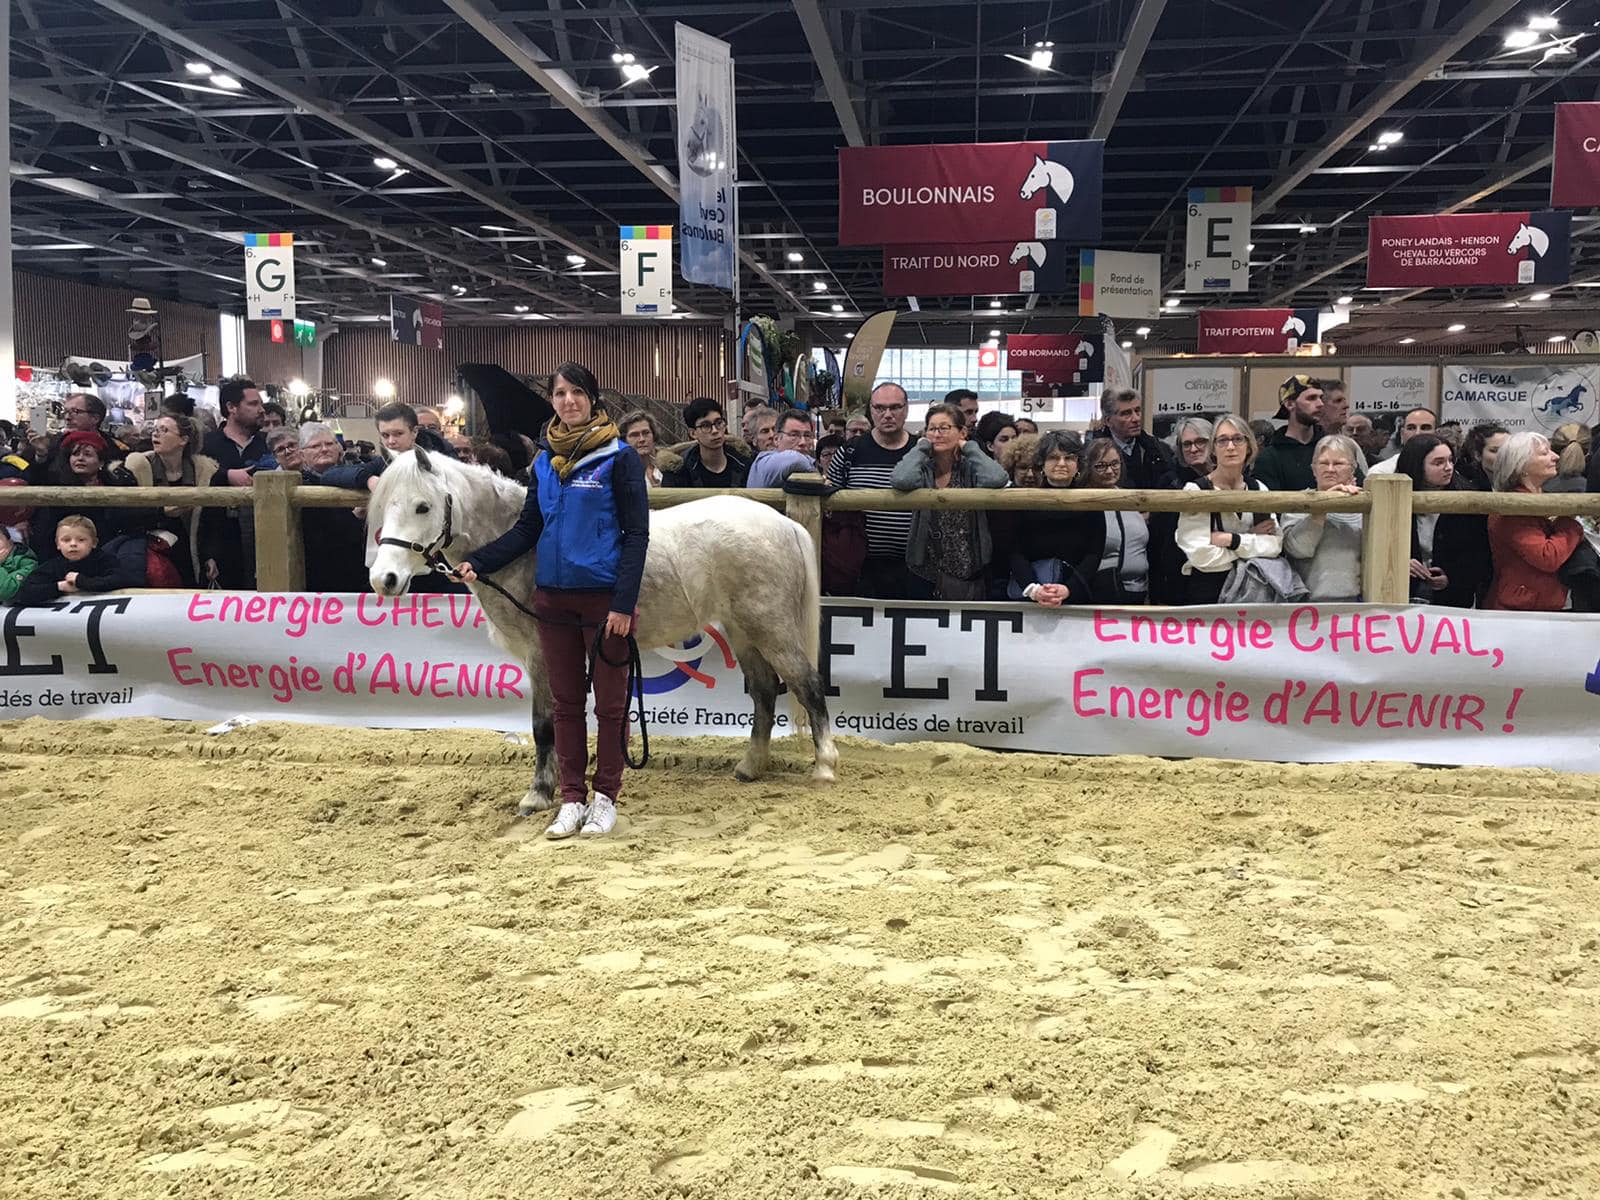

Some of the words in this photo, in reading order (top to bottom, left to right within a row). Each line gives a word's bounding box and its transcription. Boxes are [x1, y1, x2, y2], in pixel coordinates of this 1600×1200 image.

[863, 186, 995, 206] BOULONNAIS
[1189, 205, 1202, 217] 6.
[1206, 217, 1232, 258] E
[1382, 238, 1413, 247] PONEY
[1414, 237, 1453, 246] LANDAIS
[1461, 236, 1499, 245] HENSON
[622, 240, 632, 251] 6.
[246, 248, 256, 258] 6.
[1393, 249, 1428, 258] CHEVAL
[1429, 249, 1443, 257] DU
[1444, 248, 1487, 257] VERCORS
[891, 256, 931, 269] TRAIT
[934, 256, 954, 268] DU
[958, 255, 1000, 268] NORD
[1194, 260, 1202, 270] F
[1232, 260, 1240, 270] D
[1401, 258, 1413, 267] DE
[1415, 257, 1478, 266] BARRAQUAND
[255, 258, 286, 292] G
[638, 252, 658, 287] F
[1110, 273, 1132, 284] Rond
[1133, 274, 1145, 284] de
[284, 293, 289, 302] F
[627, 288, 636, 297] G
[660, 288, 665, 297] E
[1100, 286, 1153, 297] présentation
[253, 294, 260, 302] H
[1204, 327, 1231, 336] TRAIT
[1232, 327, 1275, 336] POITEVIN
[1010, 349, 1028, 357] COB
[1029, 349, 1070, 357] NORMAND
[1458, 373, 1516, 385] CHEVAL
[1444, 390, 1527, 402] CAMARGUE
[1023, 398, 1033, 413] 5
[187, 592, 343, 638] Energie
[1094, 609, 1274, 661] Energie
[1288, 606, 1504, 669] CHEVAL,
[744, 606, 1023, 702] FET
[167, 648, 323, 703] Energie
[334, 652, 524, 699] d'AVENIR
[39, 689, 64, 707] de
[71, 686, 133, 706] travail
[1072, 668, 1250, 737] Energie
[1263, 679, 1486, 732] d'AVENIR
[1501, 687, 1524, 733] !
[629, 706, 689, 724] ociété
[835, 710, 918, 734] équidés
[923, 713, 950, 733] de
[957, 715, 1025, 735] travail
